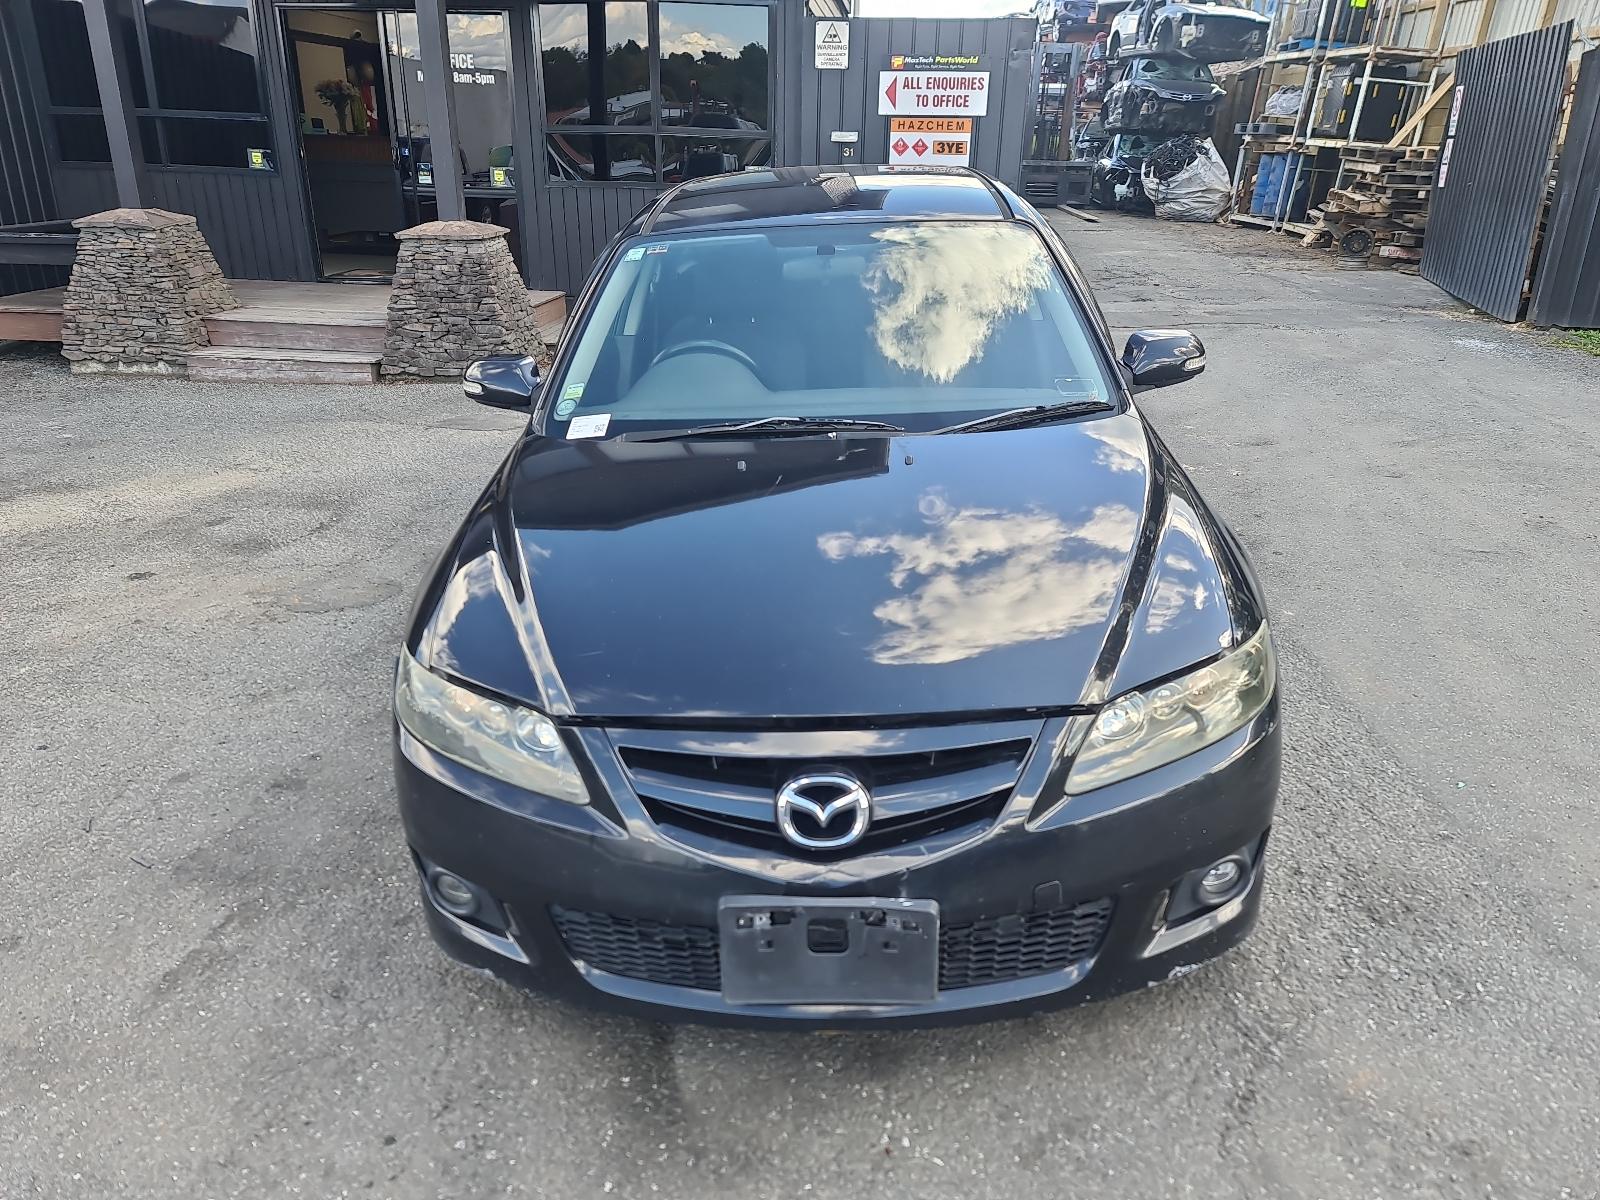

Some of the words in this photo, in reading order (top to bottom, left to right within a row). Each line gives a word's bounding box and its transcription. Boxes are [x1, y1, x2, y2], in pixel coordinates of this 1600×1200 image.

[450, 53, 475, 69] FICE
[935, 56, 979, 64] PartsWorld
[453, 71, 495, 85] 8am-5pm
[902, 76, 922, 90] ALL
[926, 76, 985, 91] ENQUIRIES
[915, 94, 929, 108] TO
[932, 94, 970, 108] OFFICE
[897, 120, 965, 131] HAZCHEM
[843, 147, 854, 157] 31
[937, 142, 964, 153] 3YE
